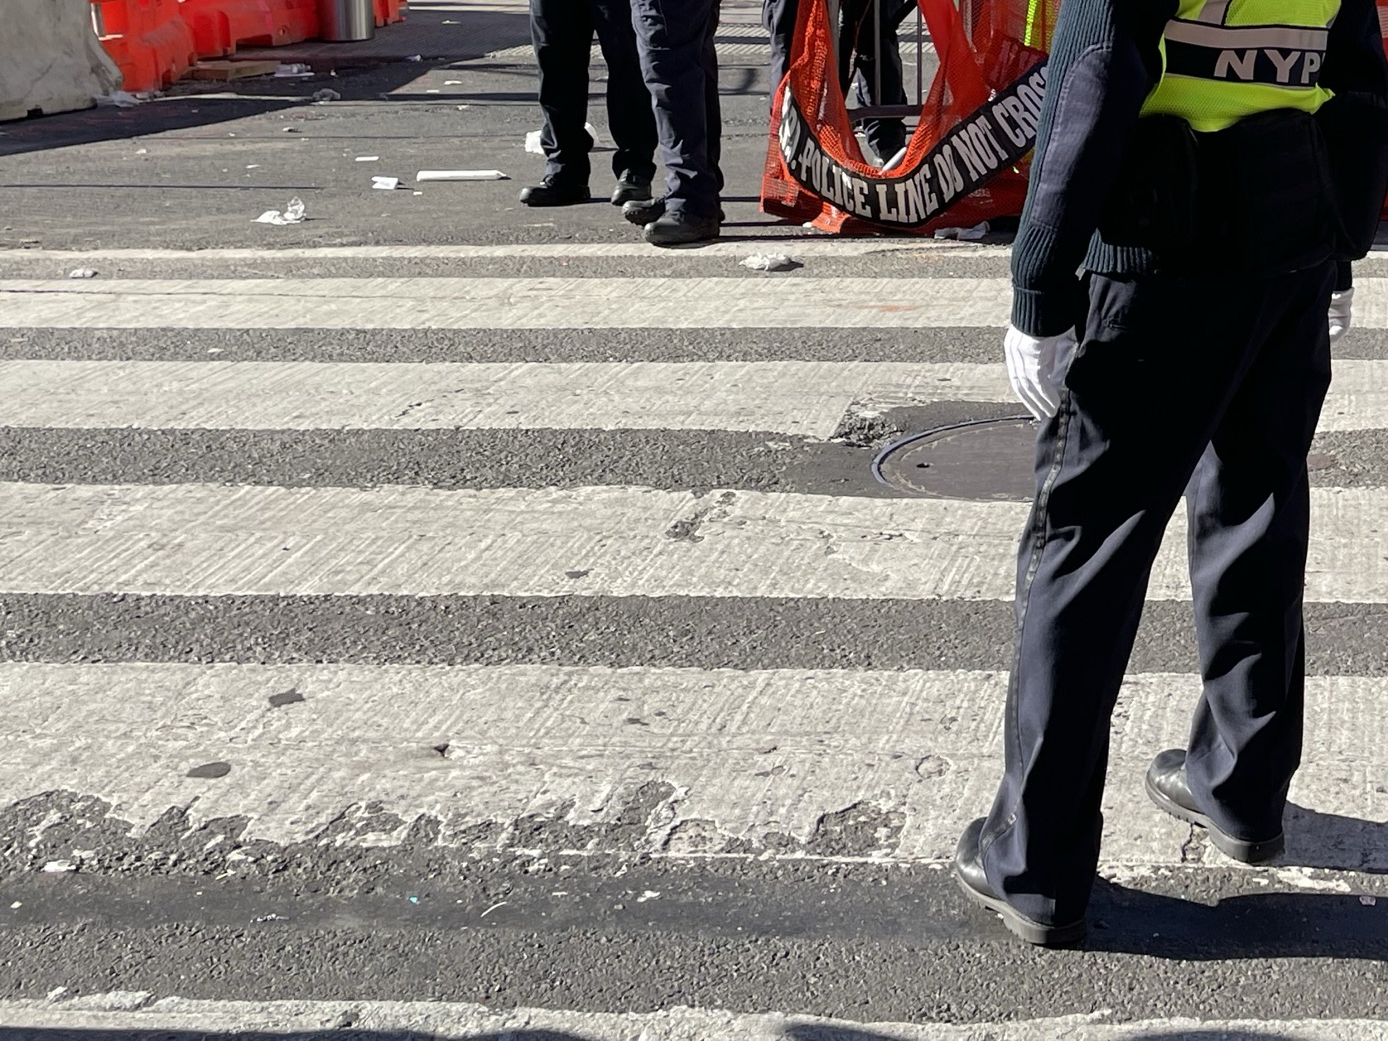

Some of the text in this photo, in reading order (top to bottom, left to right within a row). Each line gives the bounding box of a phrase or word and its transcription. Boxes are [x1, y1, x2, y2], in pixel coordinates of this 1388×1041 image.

[1214, 49, 1326, 84] NYP
[798, 66, 1049, 223] POLICE LINE DO NOT CROS
